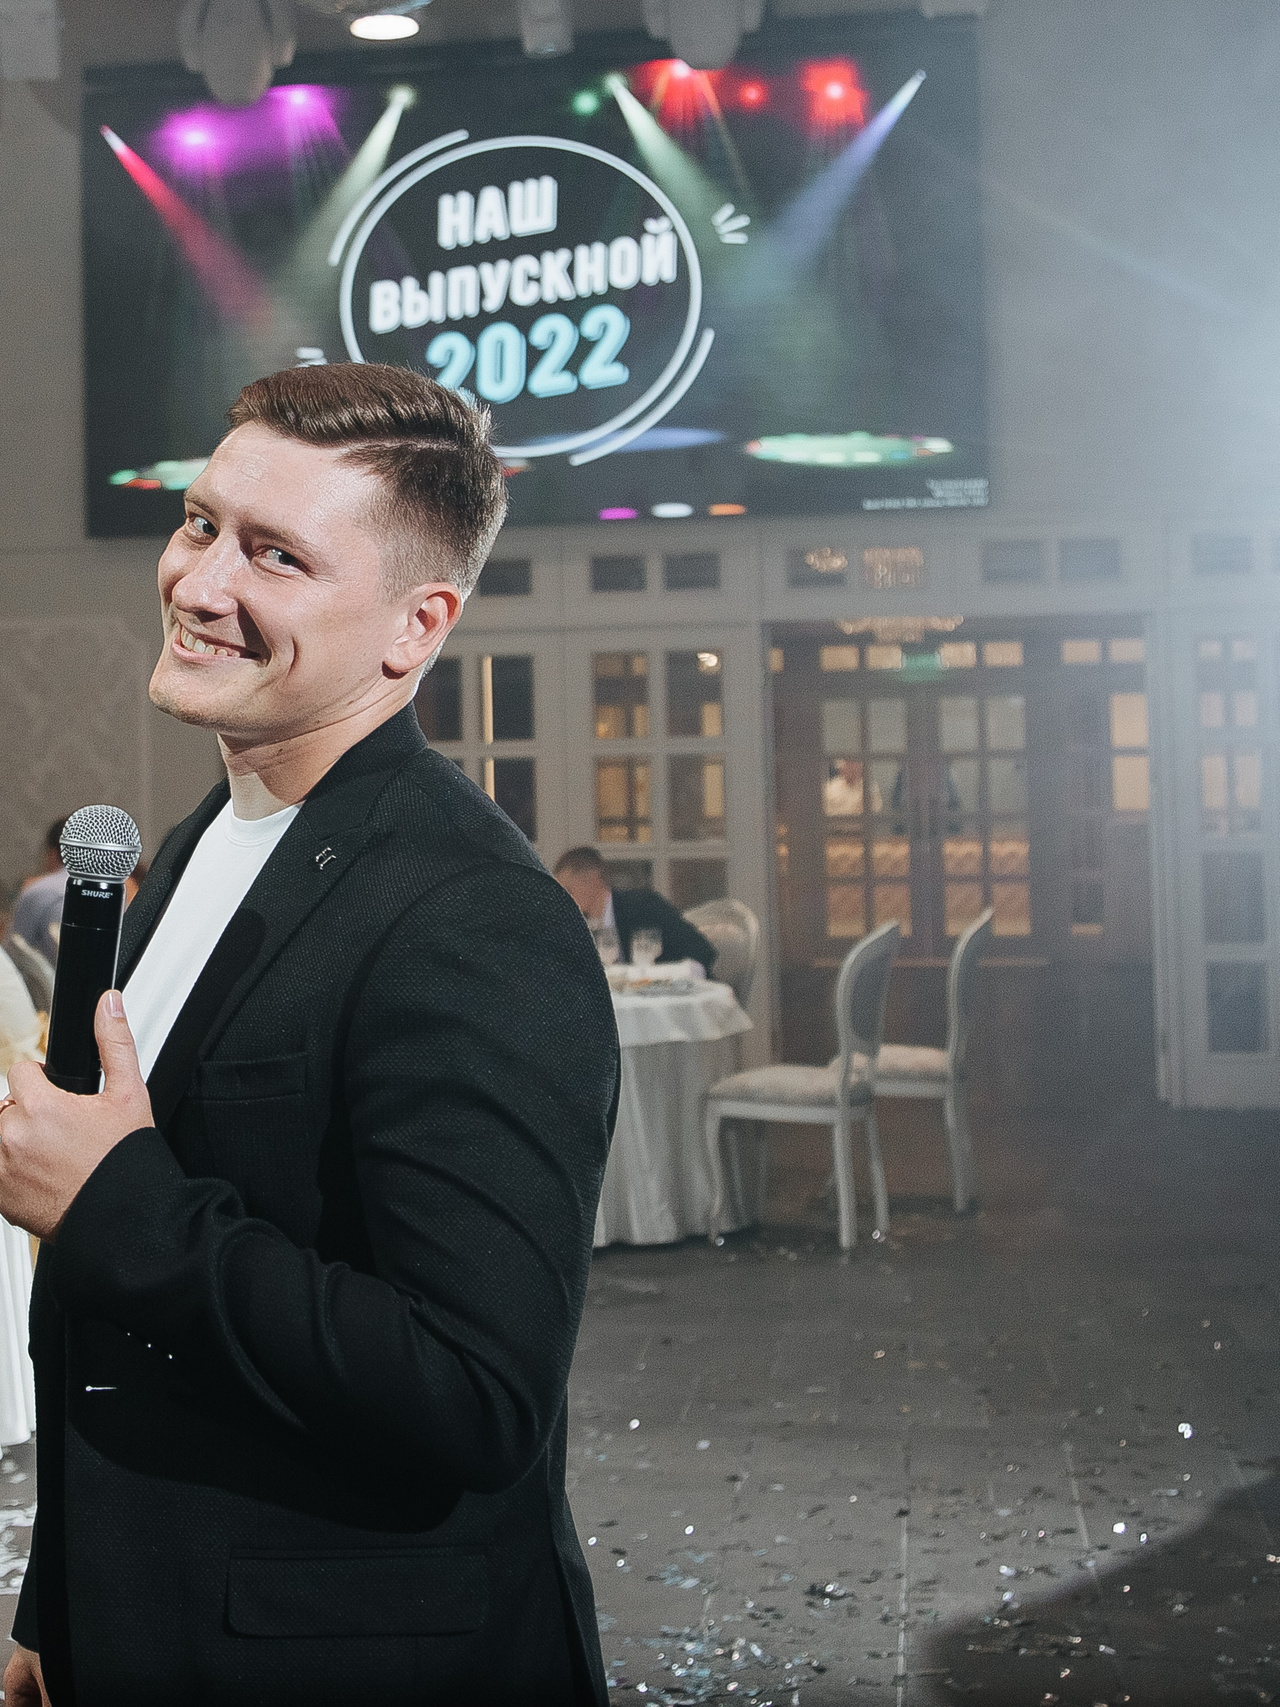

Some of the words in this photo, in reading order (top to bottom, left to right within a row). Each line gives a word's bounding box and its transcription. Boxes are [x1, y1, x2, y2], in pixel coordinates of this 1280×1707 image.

[437, 175, 558, 249] НАШ
[370, 217, 677, 333] ВЫПУСКНОЙ
[426, 304, 630, 404] 2022
[81, 889, 111, 899] SHURE
